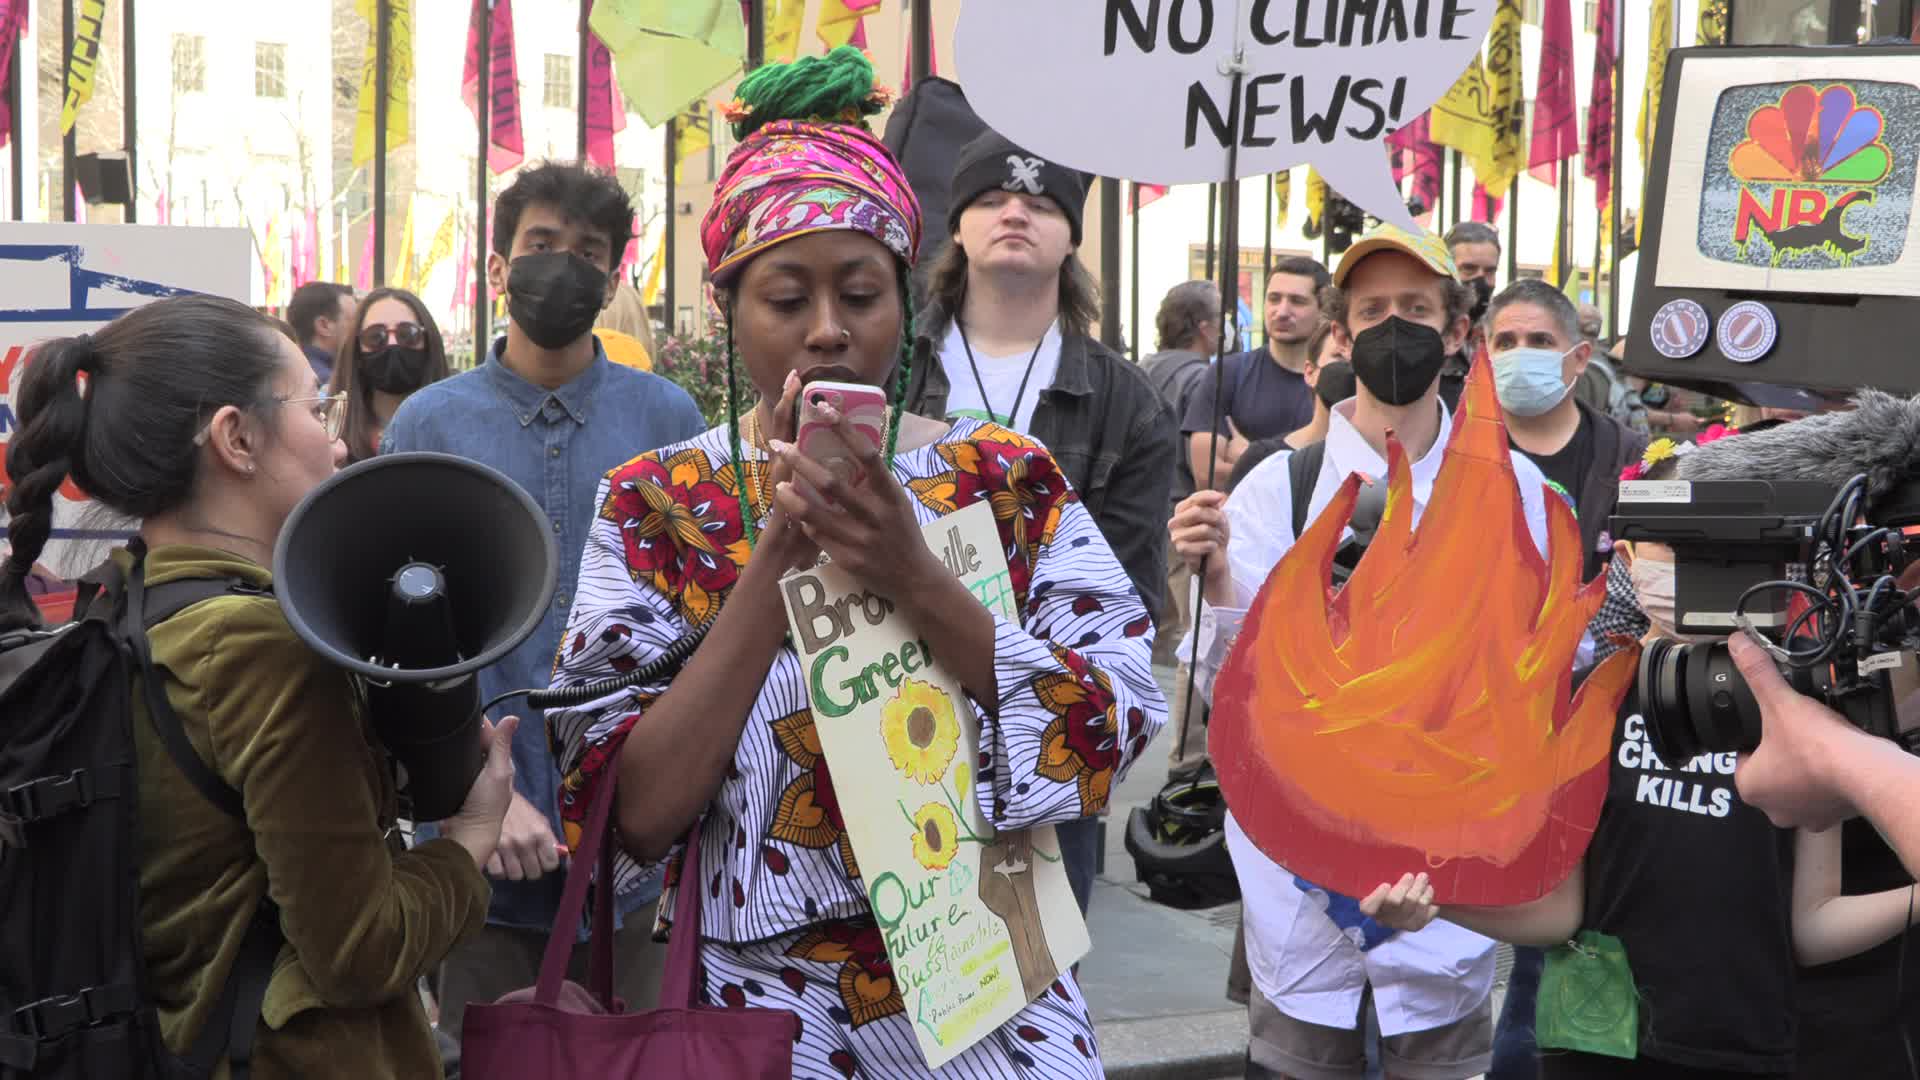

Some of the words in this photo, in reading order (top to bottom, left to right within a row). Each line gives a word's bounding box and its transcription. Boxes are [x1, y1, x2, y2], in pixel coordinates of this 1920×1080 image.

[1104, 0, 1214, 56] NO
[1249, 0, 1475, 48] CLIMATE
[1184, 72, 1407, 149] NEWS!
[1636, 775, 1732, 818] KILLS
[870, 871, 943, 928] Our
